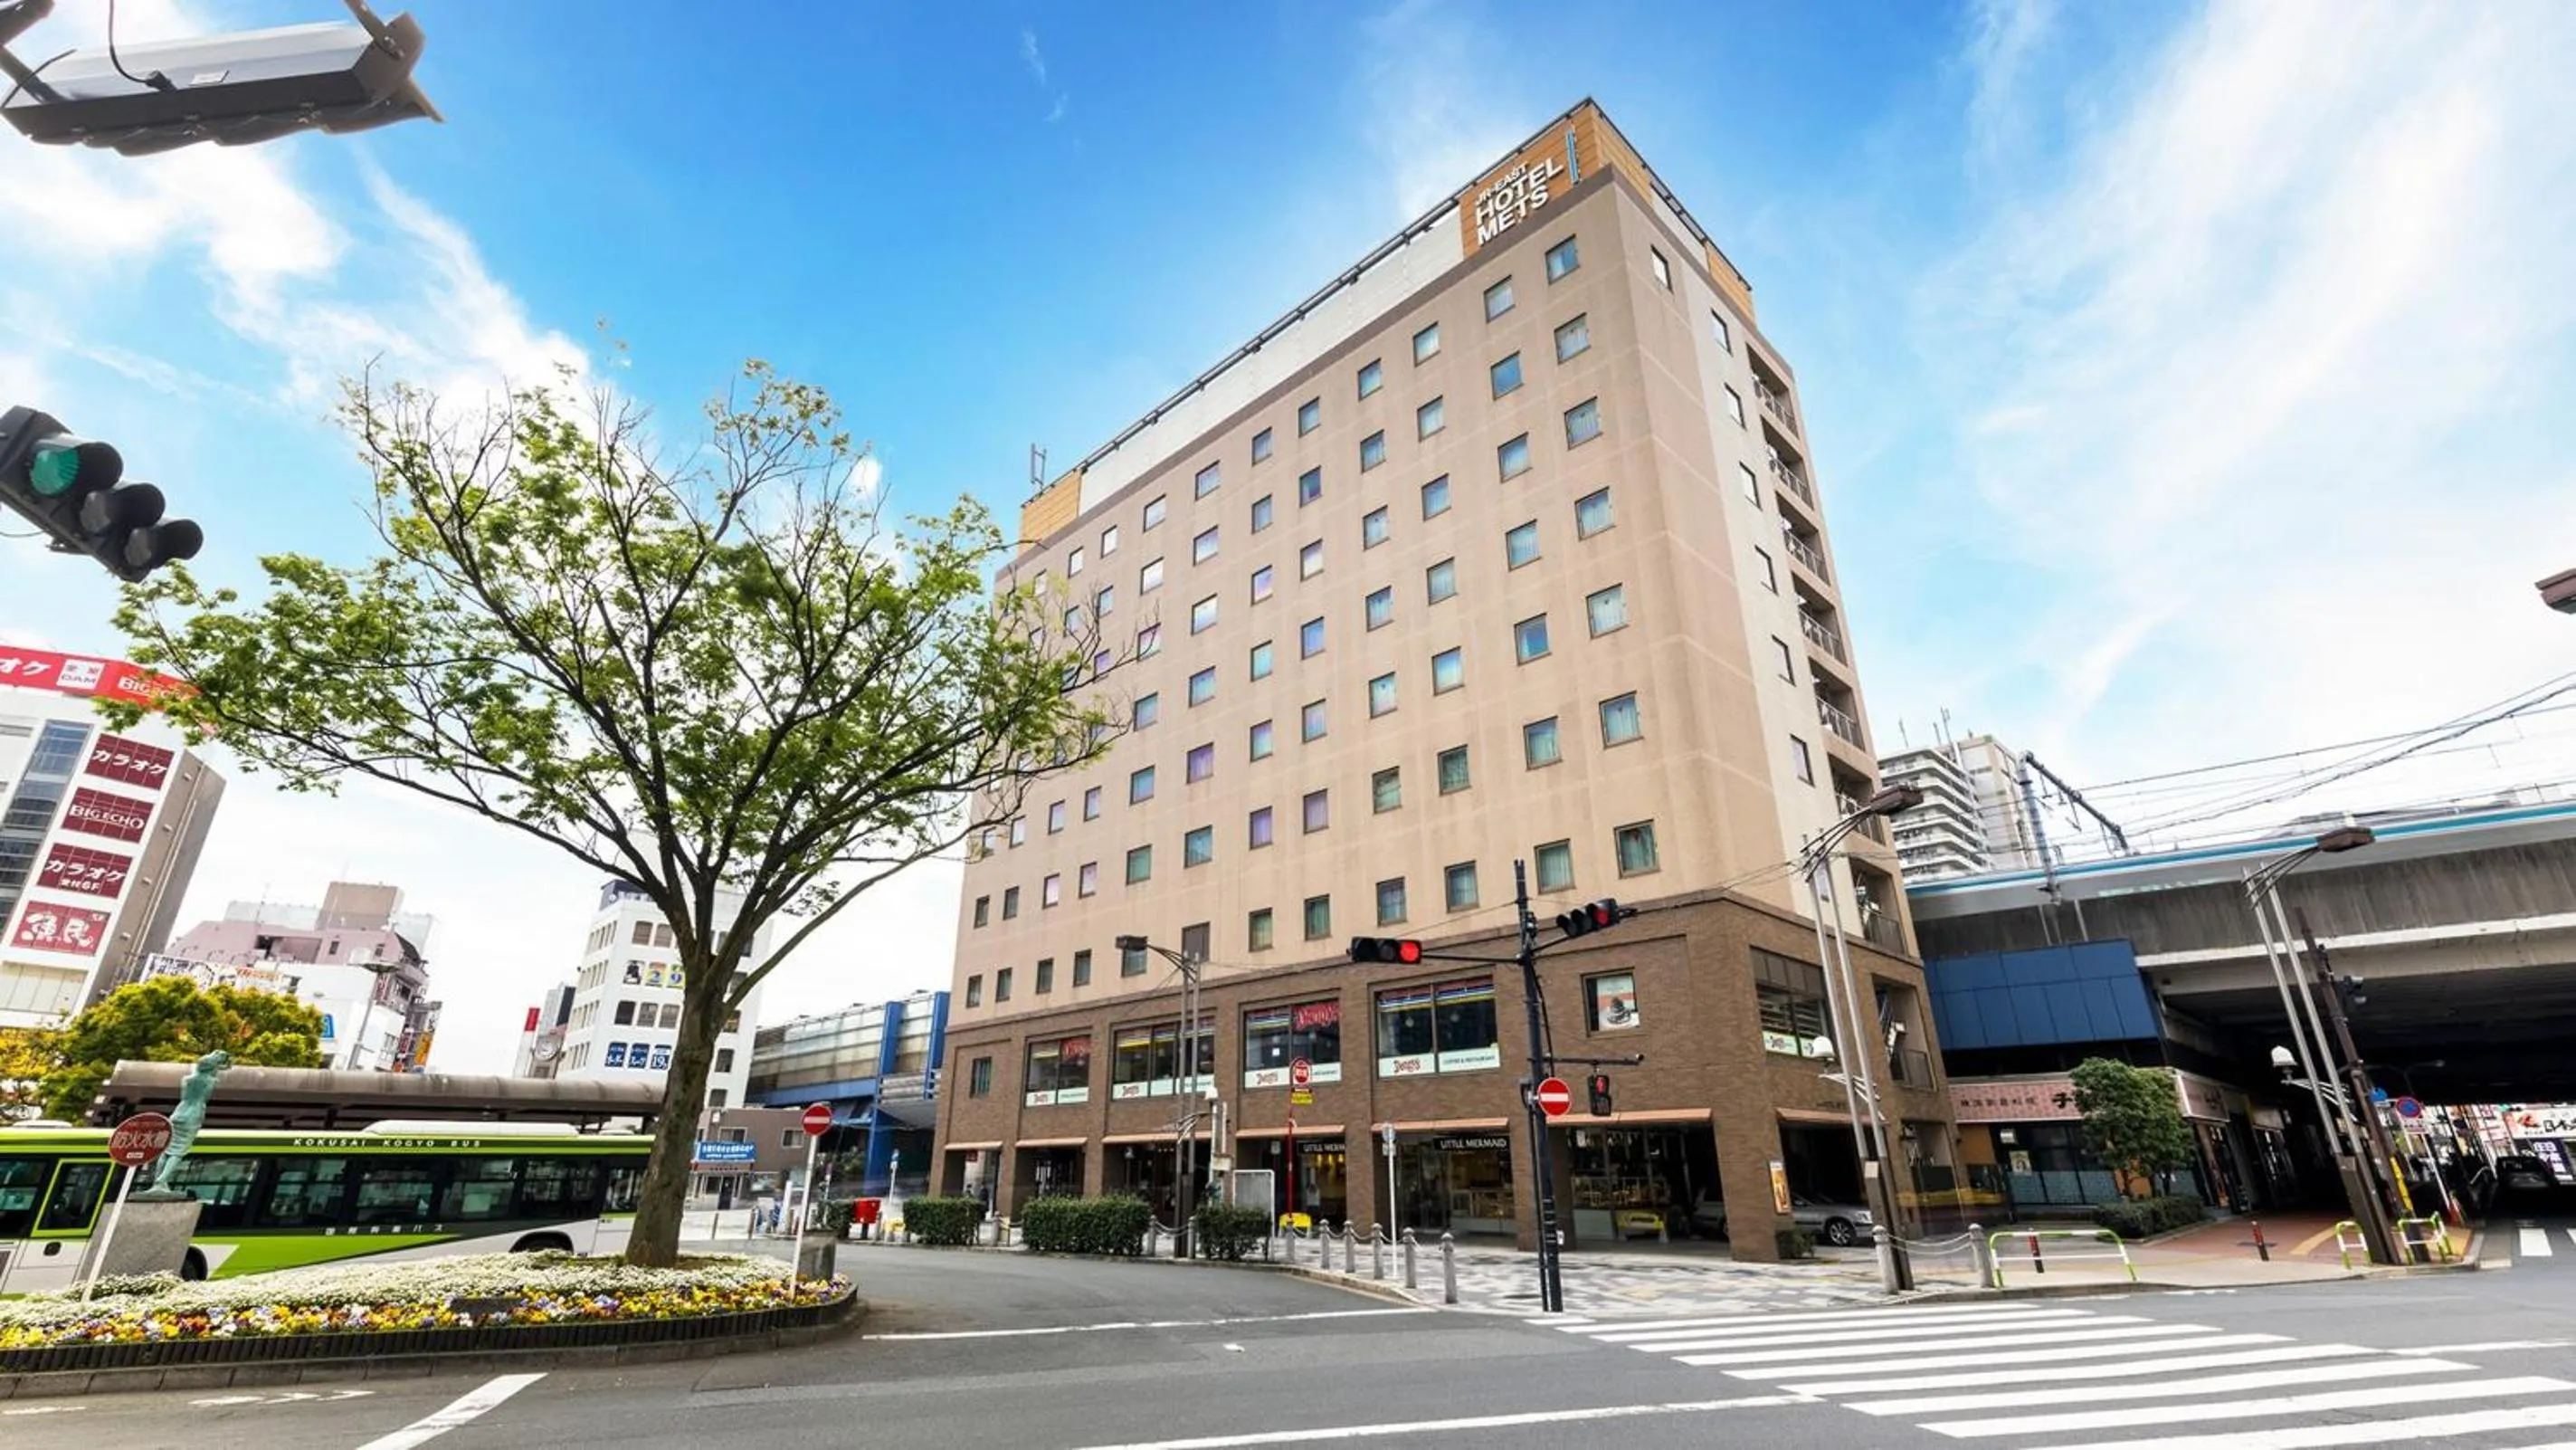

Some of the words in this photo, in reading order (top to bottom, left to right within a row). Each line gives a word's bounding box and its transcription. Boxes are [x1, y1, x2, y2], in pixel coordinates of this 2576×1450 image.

[1475, 157, 1564, 226] HOTEL
[1476, 185, 1549, 246] METS
[91, 749, 167, 775] カラオケ
[69, 805, 100, 820] BIG
[102, 812, 145, 830] ECHO
[44, 859, 127, 882] カラオケ
[293, 1138, 366, 1148] KOKUSAI
[382, 1139, 435, 1148] KOGYO
[450, 1139, 481, 1148] BUS
